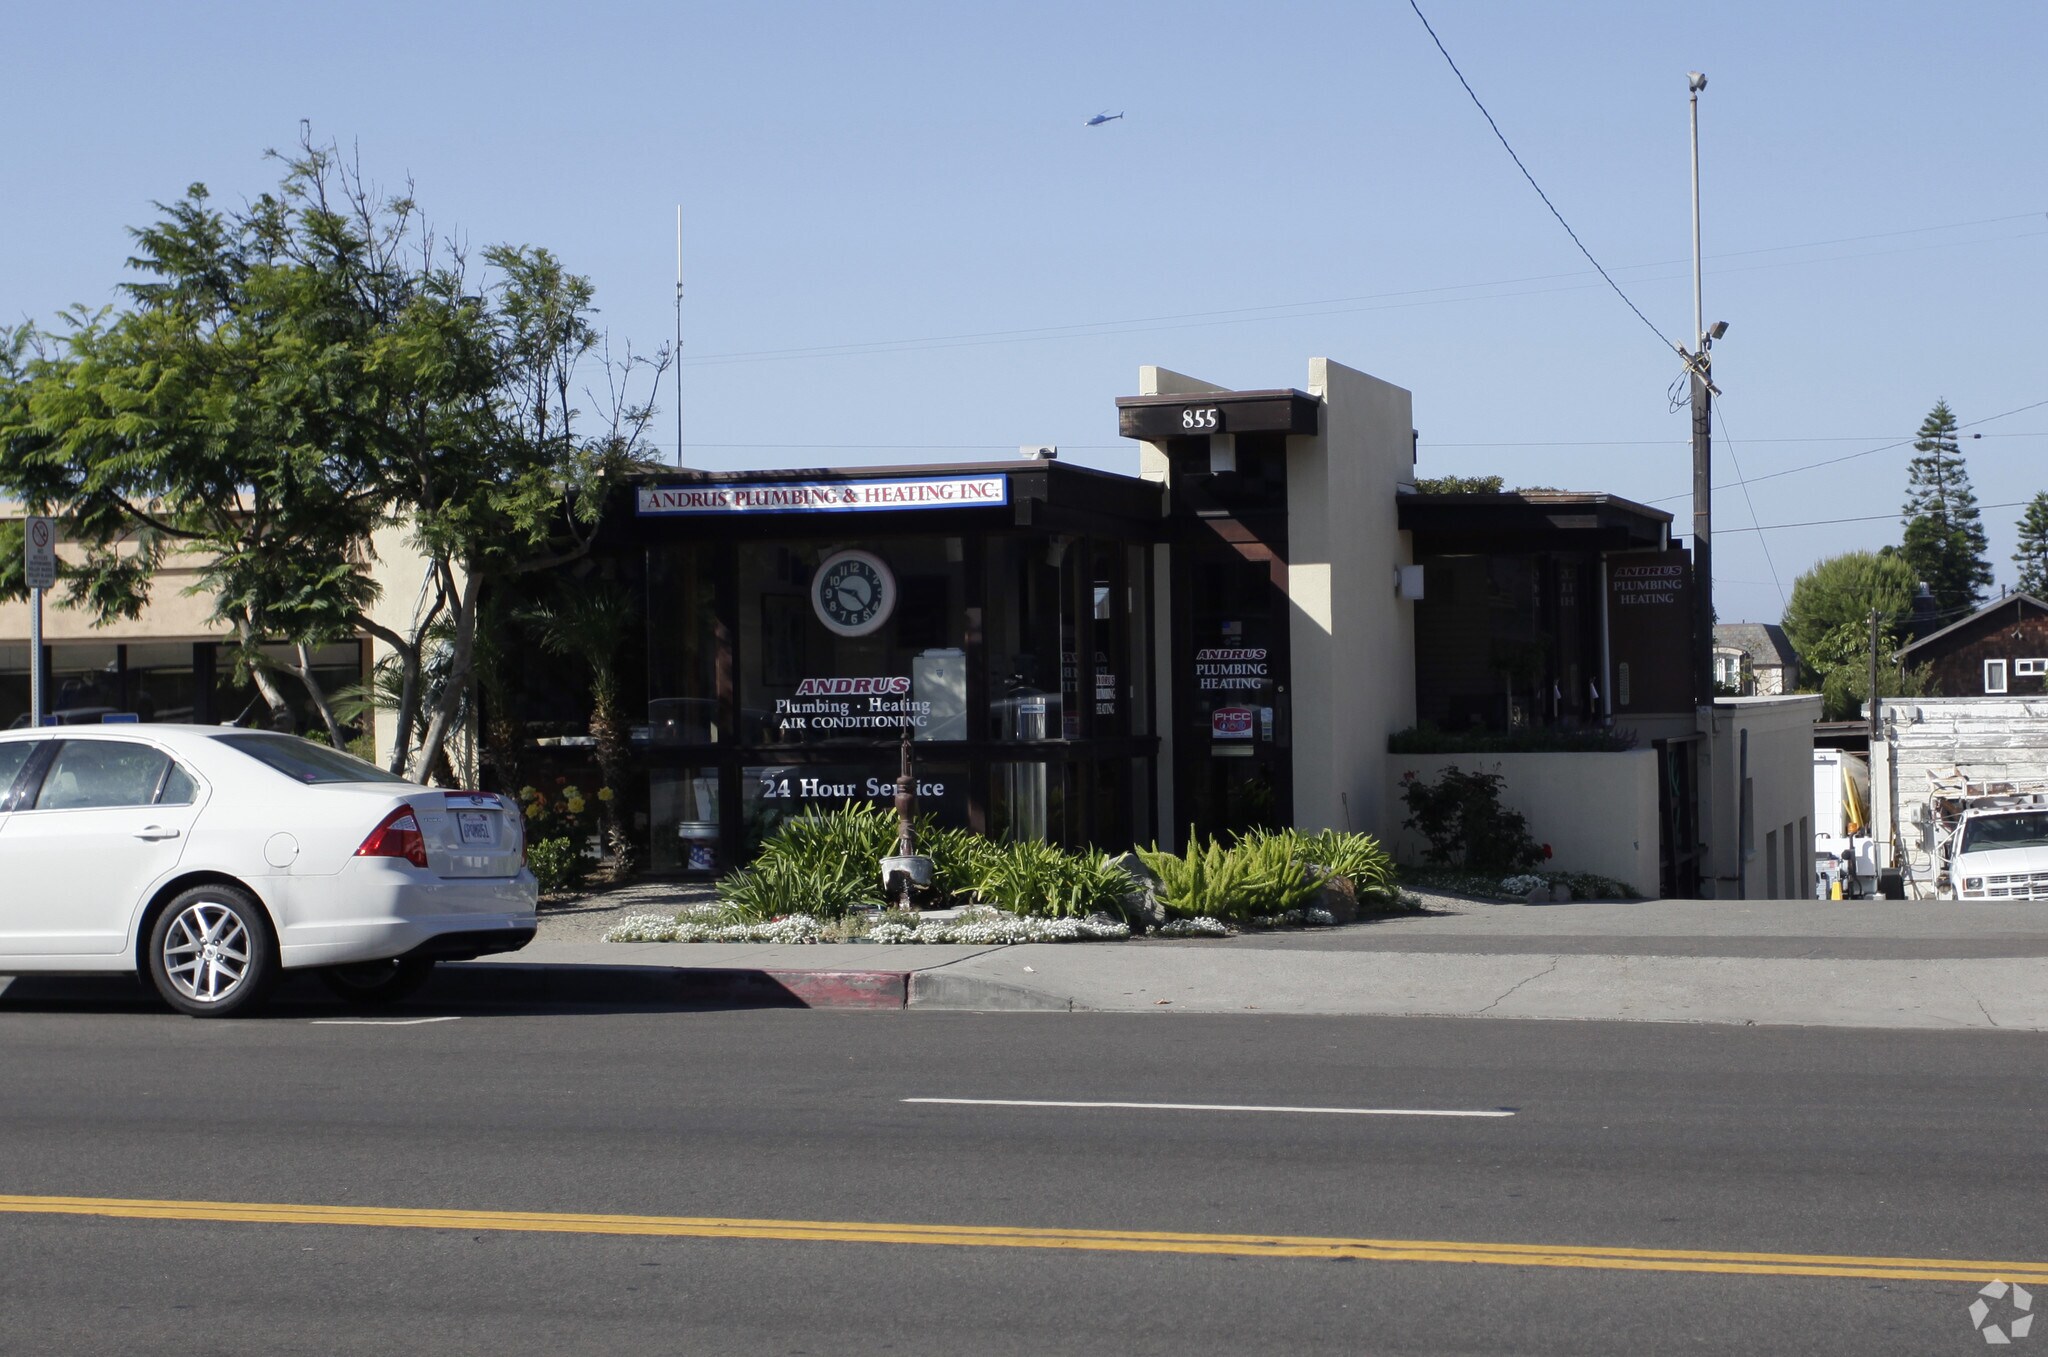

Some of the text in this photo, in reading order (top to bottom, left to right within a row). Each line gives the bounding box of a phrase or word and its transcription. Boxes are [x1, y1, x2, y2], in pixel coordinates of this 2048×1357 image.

[1182, 408, 1217, 429] 855
[648, 491, 728, 508] ANDRUS
[735, 487, 838, 506] PLUMBING
[842, 488, 859, 504] &
[864, 484, 953, 503] HEATING
[840, 566, 848, 576] 11
[850, 562, 860, 573] 12
[1613, 565, 1683, 577] ANDRUS
[830, 576, 840, 586] 10
[872, 575, 879, 585] 2
[1613, 579, 1682, 591] PLUMBING
[825, 588, 833, 599] 9
[1621, 592, 1674, 605] HEATING
[829, 601, 837, 611] 8
[840, 611, 846, 621] 7
[850, 614, 858, 624] 6
[1196, 648, 1267, 660] ANDRUS
[1196, 663, 1267, 675] PLUMBING
[795, 677, 911, 696] ANDRUS
[1200, 677, 1262, 689] HEATING
[776, 697, 931, 717] Plumbing Heating
[779, 715, 928, 729] AIR CONDITIONING
[1214, 712, 1252, 721] PHCC
[763, 777, 945, 798] 24 Hour Serice
